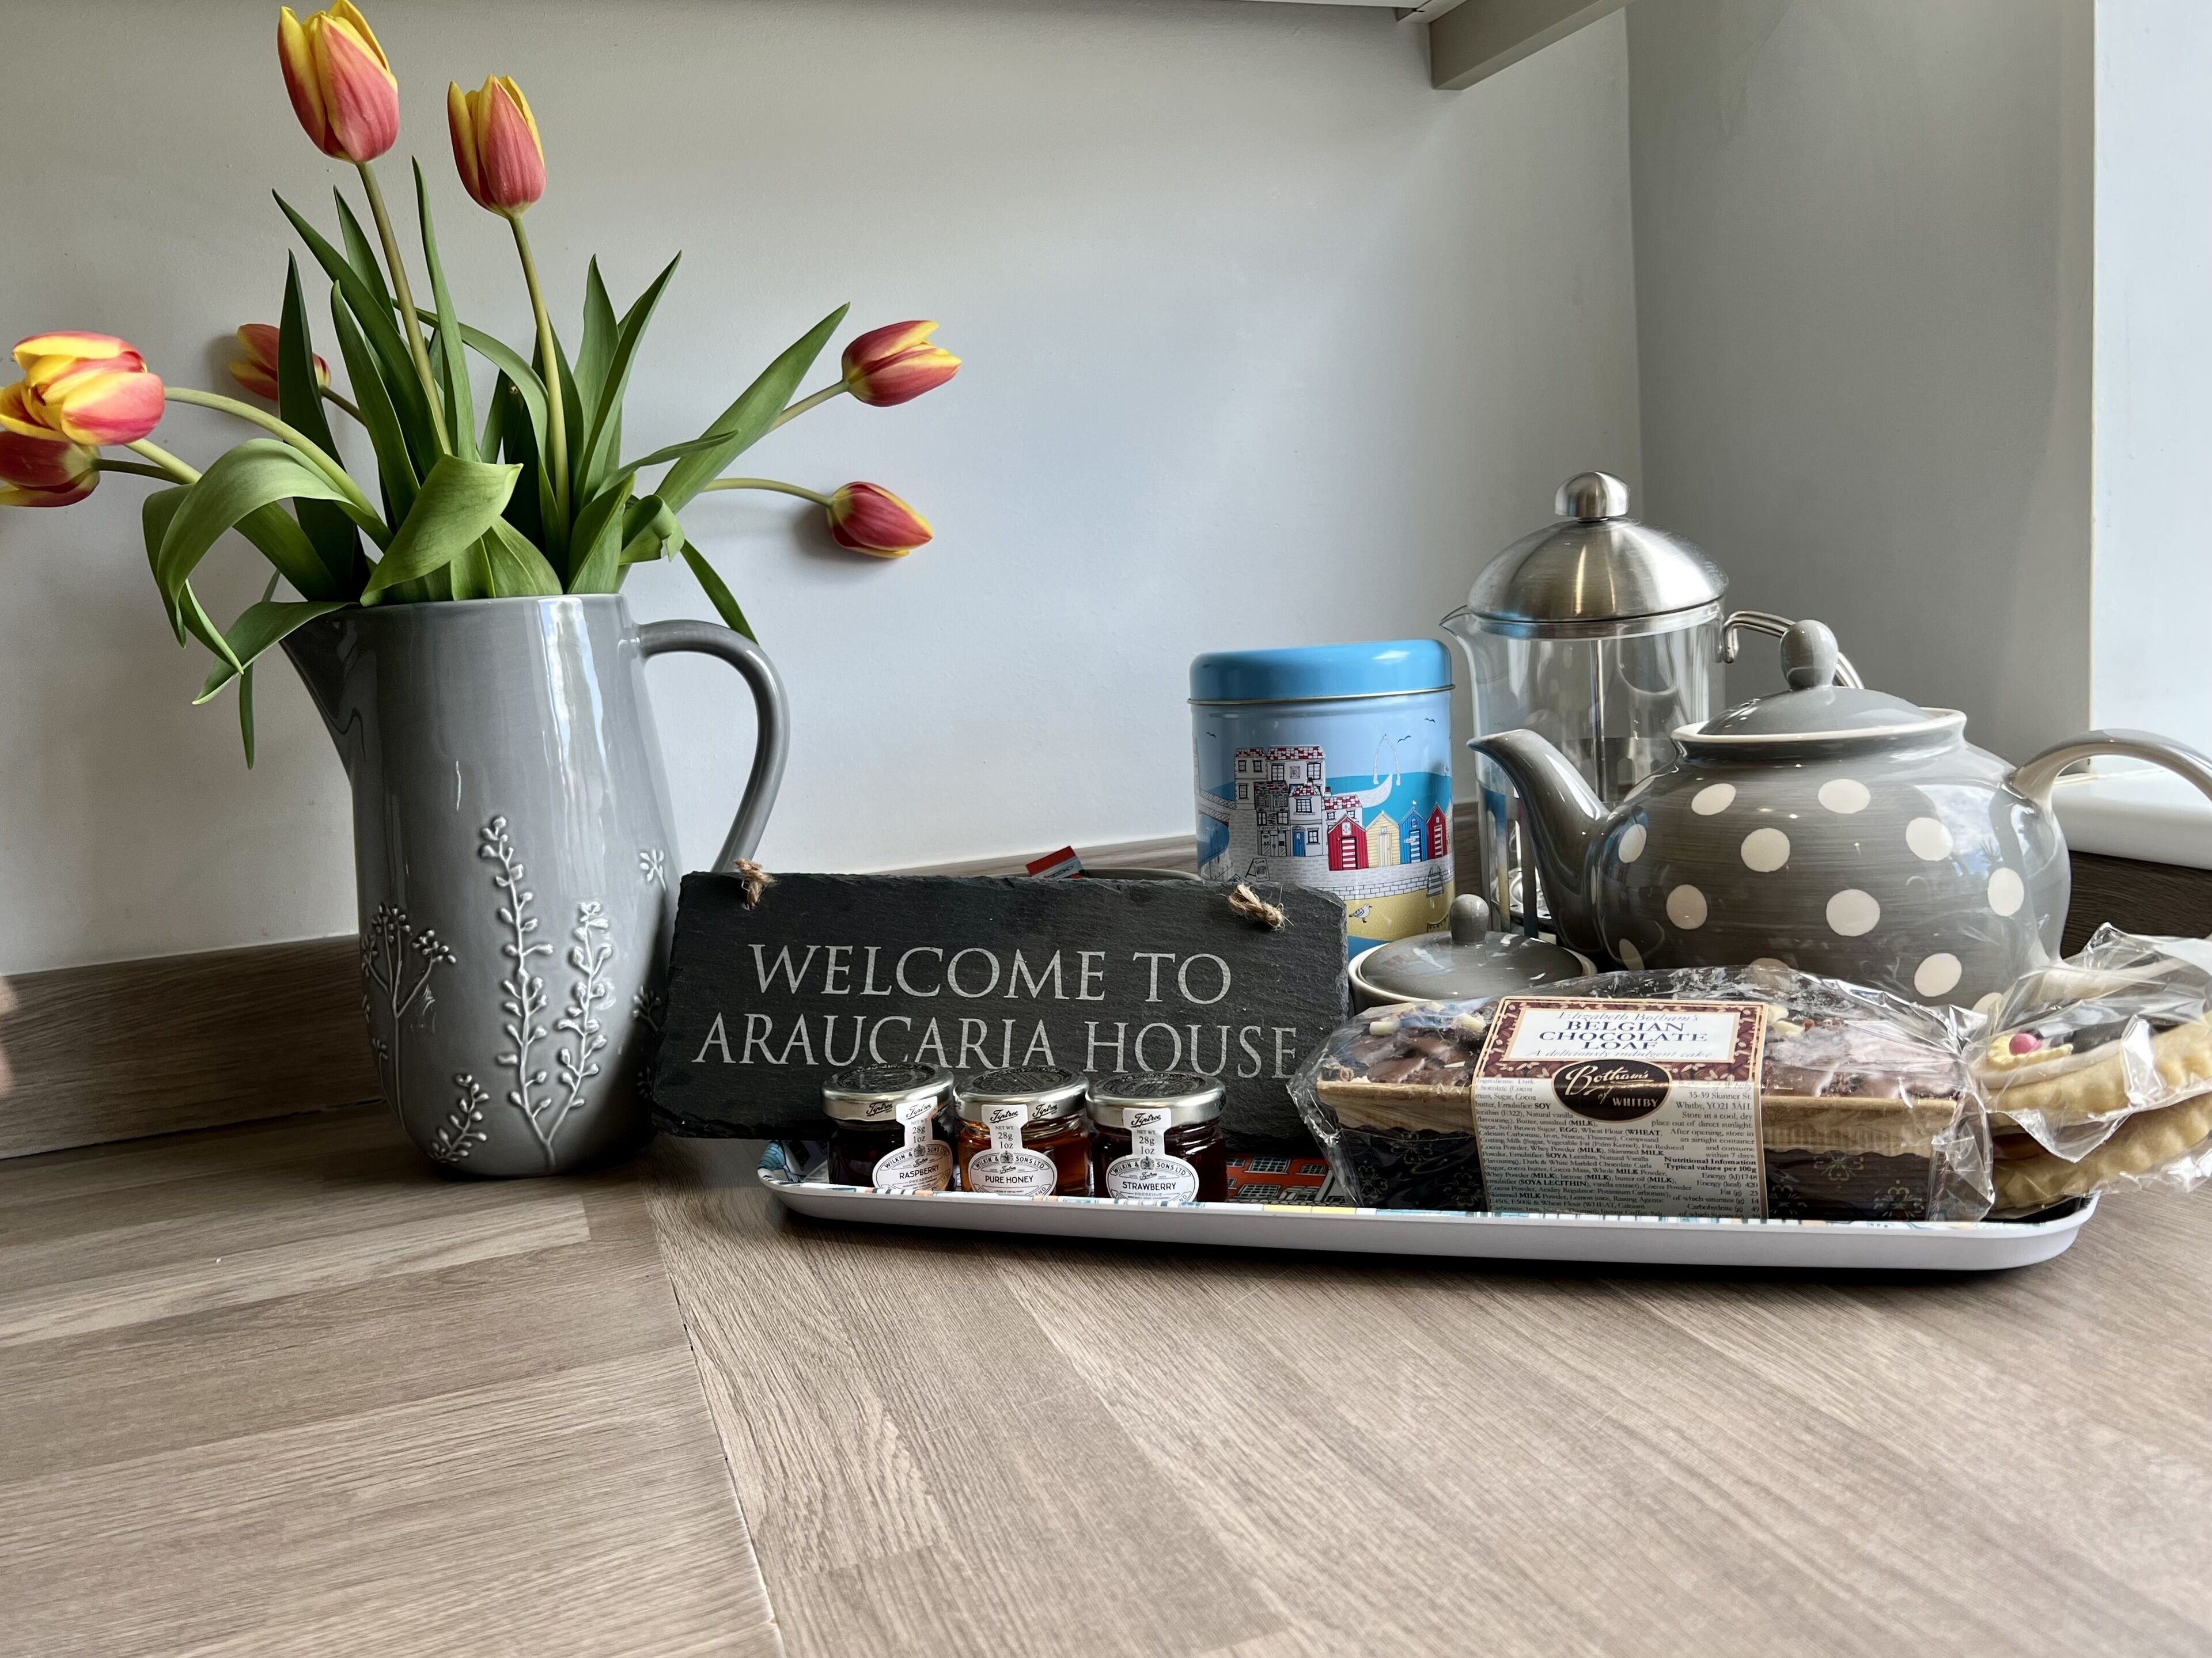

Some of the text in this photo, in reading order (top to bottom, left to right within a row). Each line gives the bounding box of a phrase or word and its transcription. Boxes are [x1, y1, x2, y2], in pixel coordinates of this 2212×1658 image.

[748, 944, 1231, 1004] WELCOME TO
[1558, 1012, 1699, 1022] Elizabeth Botham's
[1566, 1020, 1685, 1031] BELGIAN
[1539, 1031, 1708, 1042] CHOCOLATE
[692, 1012, 1297, 1079] ARAUCARIA HOUSE
[1581, 1041, 1658, 1050] LOAF
[1546, 1049, 1611, 1058] deliciously
[1615, 1050, 1676, 1059] indulgent
[1565, 1065, 1649, 1096] Botham's
[1494, 1093, 1514, 1101] Sugar,
[1711, 1092, 1740, 1100] Skinner
[1475, 1101, 1496, 1109] butter,
[1613, 1097, 1658, 1107] WHITBY
[1676, 1101, 1728, 1111] Whitby, YO21
[906, 1103, 931, 1120] Tiptree
[990, 1109, 1018, 1124] Tiptree
[1130, 1113, 1161, 1128] Tiptree
[1719, 1113, 1738, 1121] cool,
[1740, 1113, 1753, 1121] dry
[1569, 1120, 1598, 1128] (MILK),
[1722, 1121, 1753, 1129] sunlight.
[912, 1126, 926, 1134] 28g
[1625, 1129, 1663, 1137] (WHEAT,
[1691, 1129, 1724, 1137] opening,
[998, 1132, 1013, 1141] 28g
[1139, 1136, 1155, 1146] 28g
[1000, 1141, 1014, 1149] 1oz
[1141, 1146, 1155, 1155] 1oz
[884, 1154, 905, 1169] WILKIN
[975, 1156, 992, 1167] WILKIN
[1016, 1156, 1033, 1164] SONS
[1033, 1160, 1045, 1168] LTD
[899, 1164, 939, 1179] RASPBERRY
[1112, 1163, 1131, 1174] WILKIN
[1157, 1162, 1174, 1172] SONS
[1175, 1167, 1186, 1175] LTD
[1665, 1163, 1694, 1171] Typical
[985, 1175, 1033, 1183] PURE HONEY
[1122, 1181, 1176, 1190] STRAWBERRY
